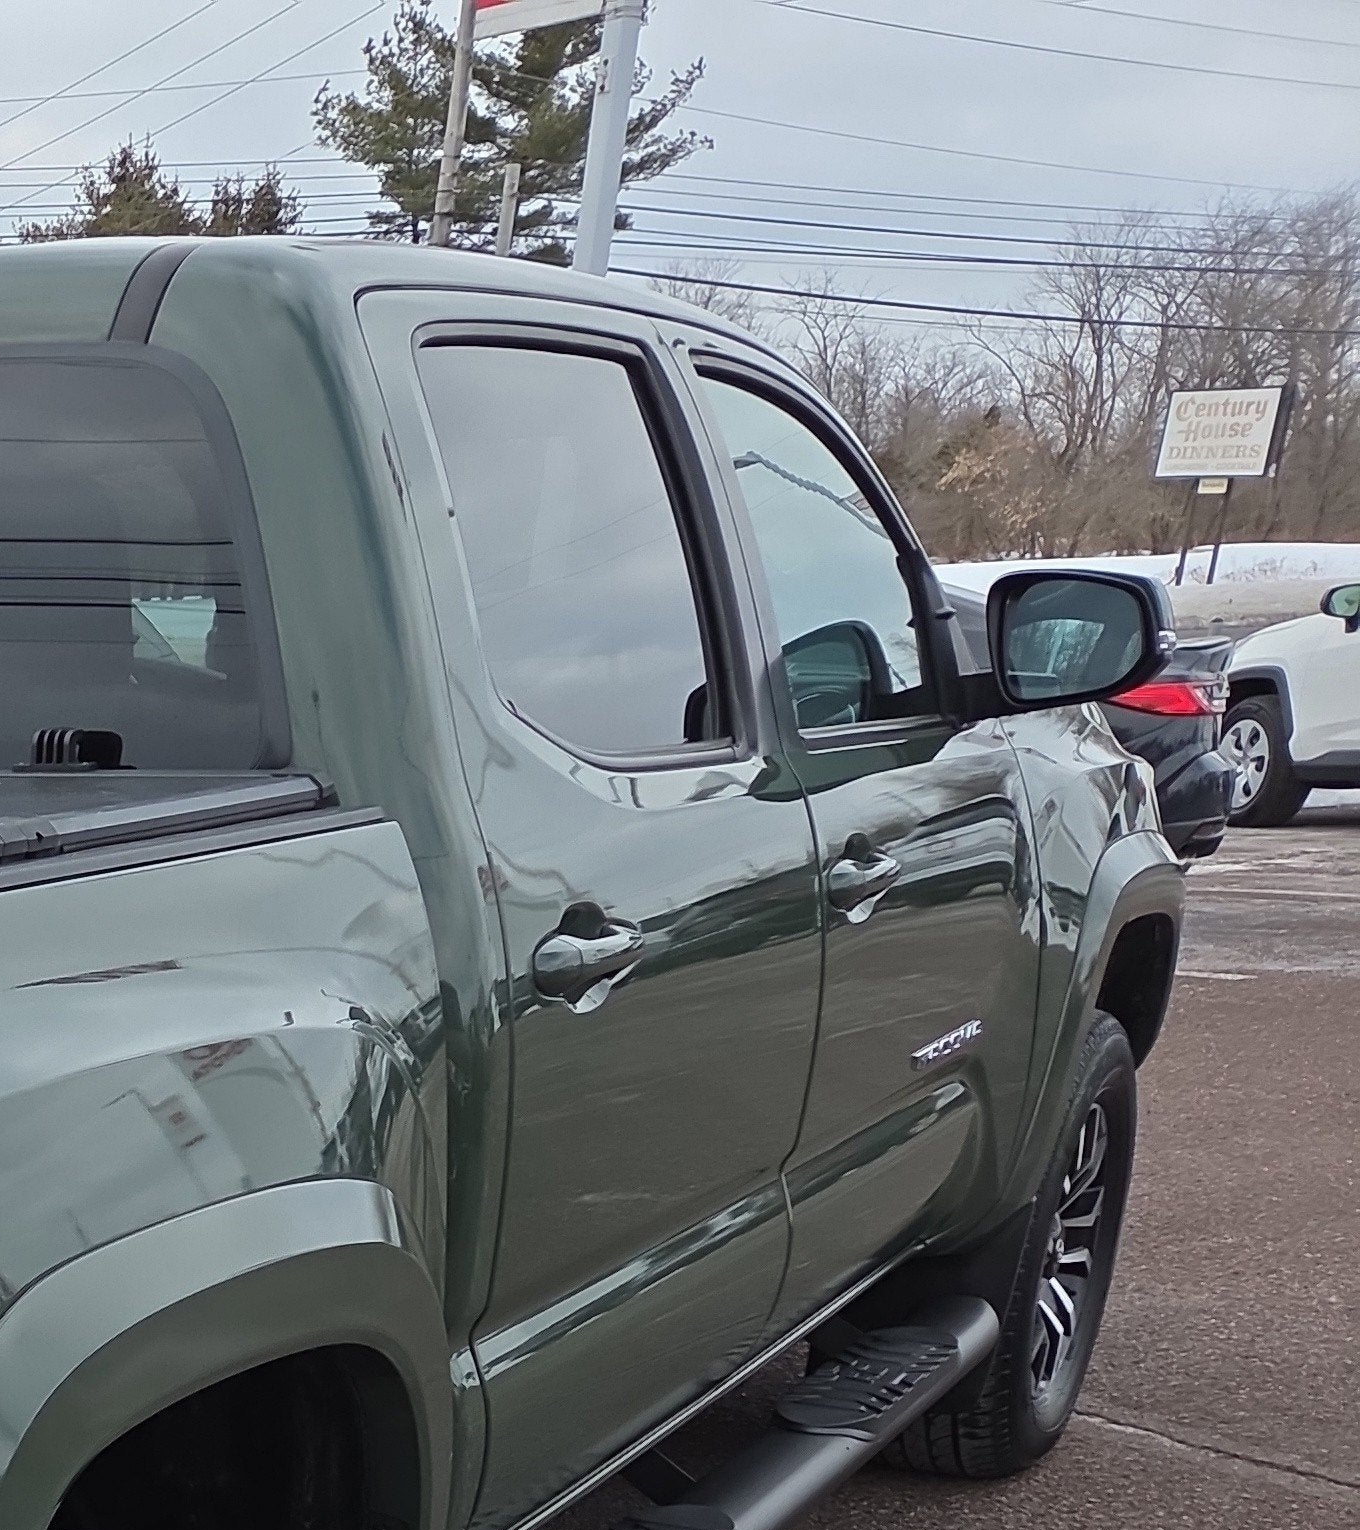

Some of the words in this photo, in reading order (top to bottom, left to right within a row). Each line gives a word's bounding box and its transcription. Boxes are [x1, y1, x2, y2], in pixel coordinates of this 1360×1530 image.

[1175, 395, 1269, 422] Century
[1177, 420, 1254, 443] House
[1166, 444, 1262, 460] DINNERS
